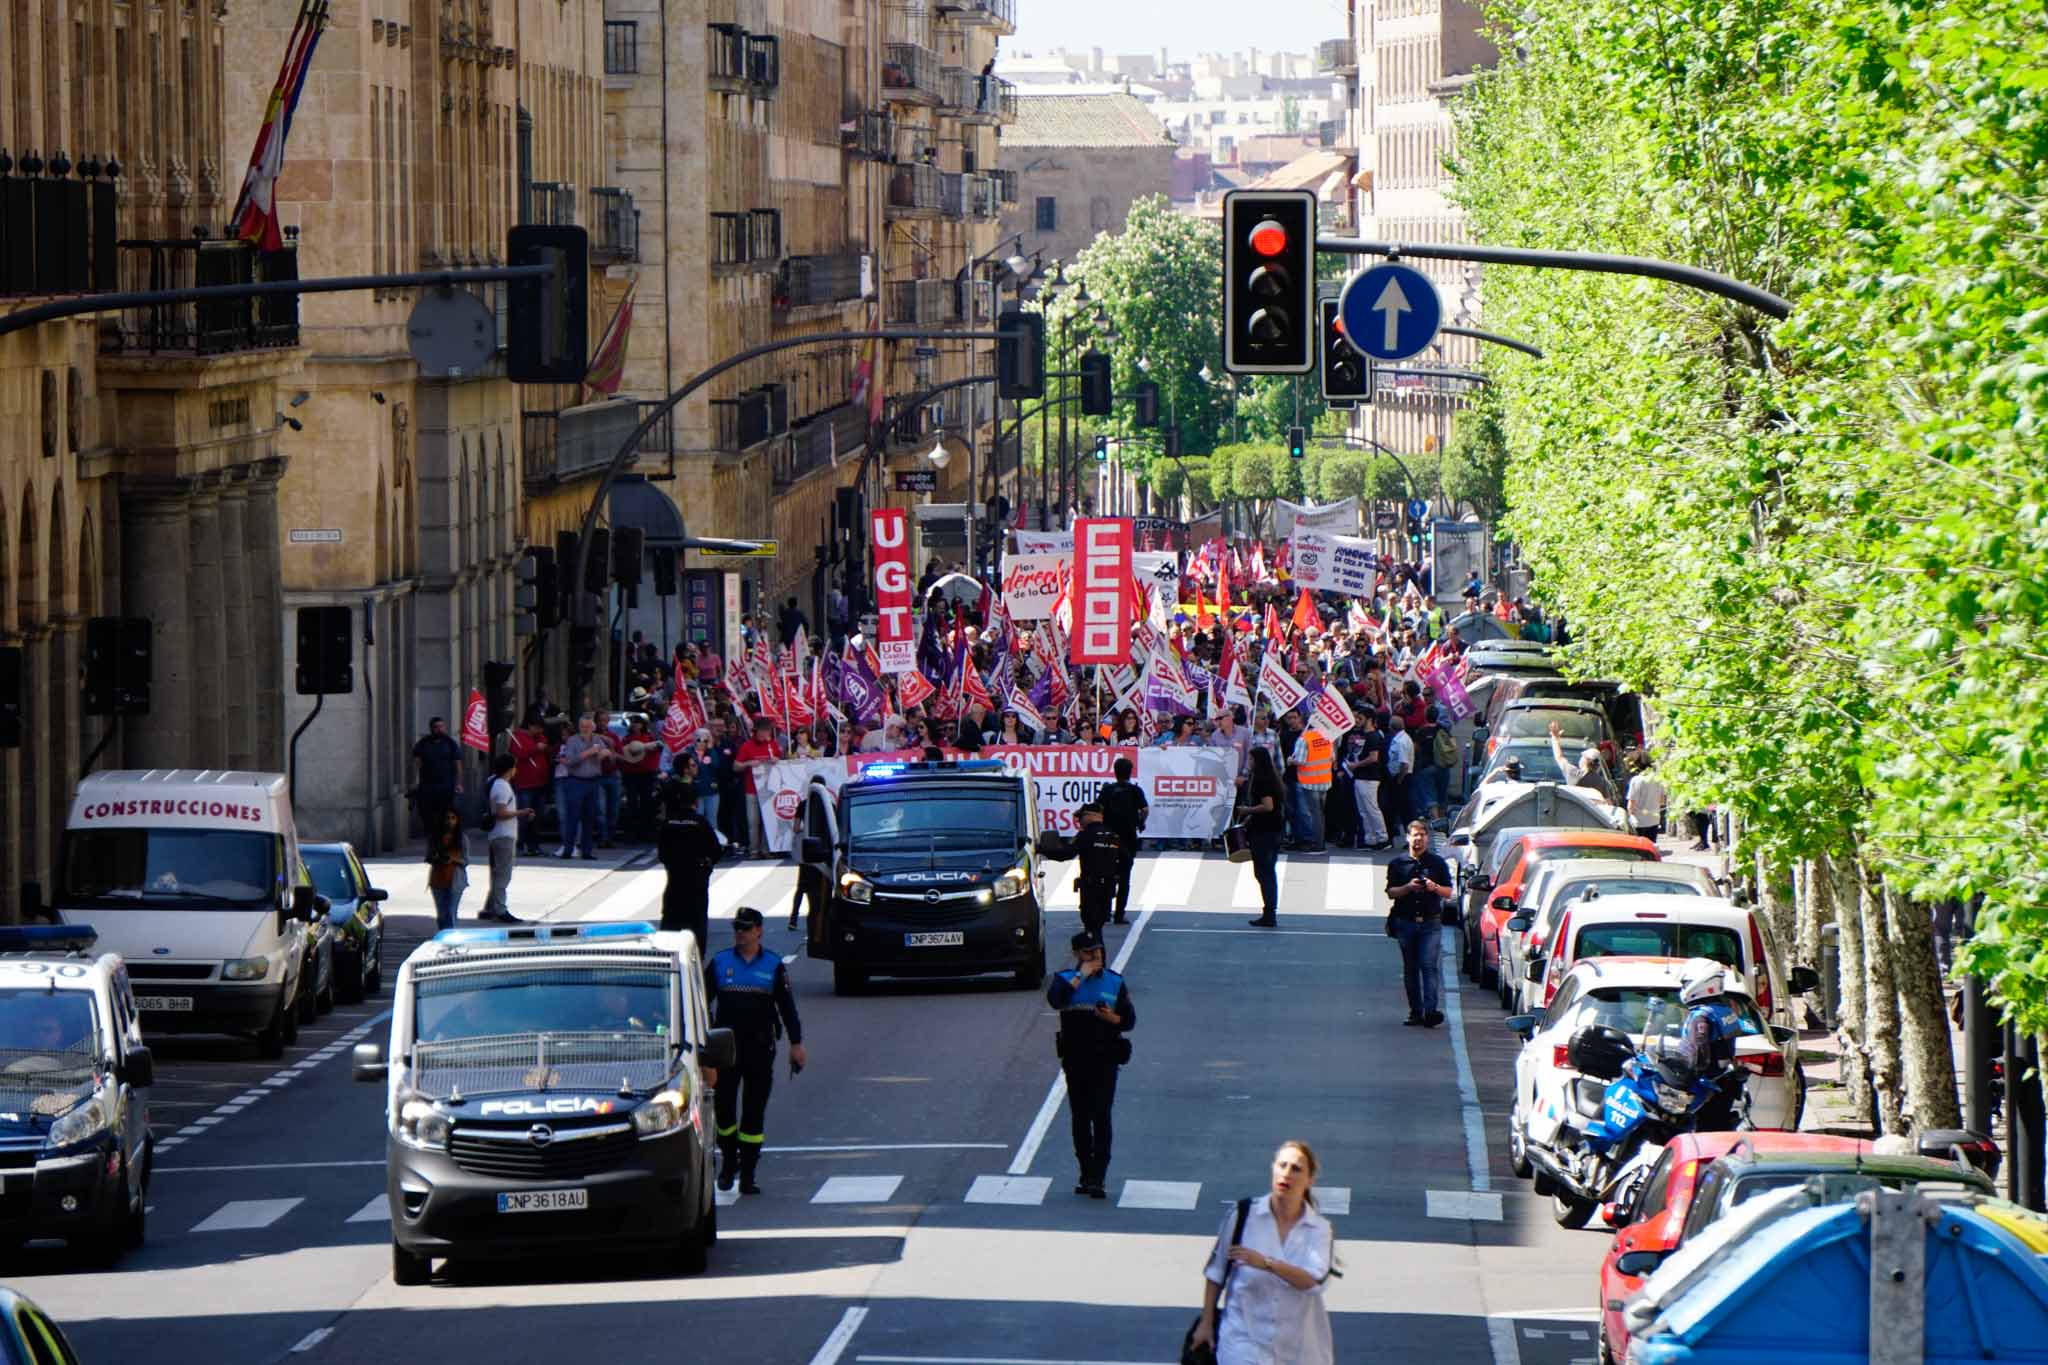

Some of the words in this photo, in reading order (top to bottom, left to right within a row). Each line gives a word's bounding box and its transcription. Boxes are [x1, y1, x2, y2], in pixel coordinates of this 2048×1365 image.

[874, 516, 908, 637] UGT
[1014, 590, 1025, 599] de
[1028, 588, 1038, 596] la
[1084, 523, 1120, 655] CCOO
[882, 642, 910, 653] UGT
[1158, 779, 1212, 793] CCOO
[84, 799, 262, 822] CONSTRUCCIONES
[507, 1192, 585, 1209] CNP3618AU
